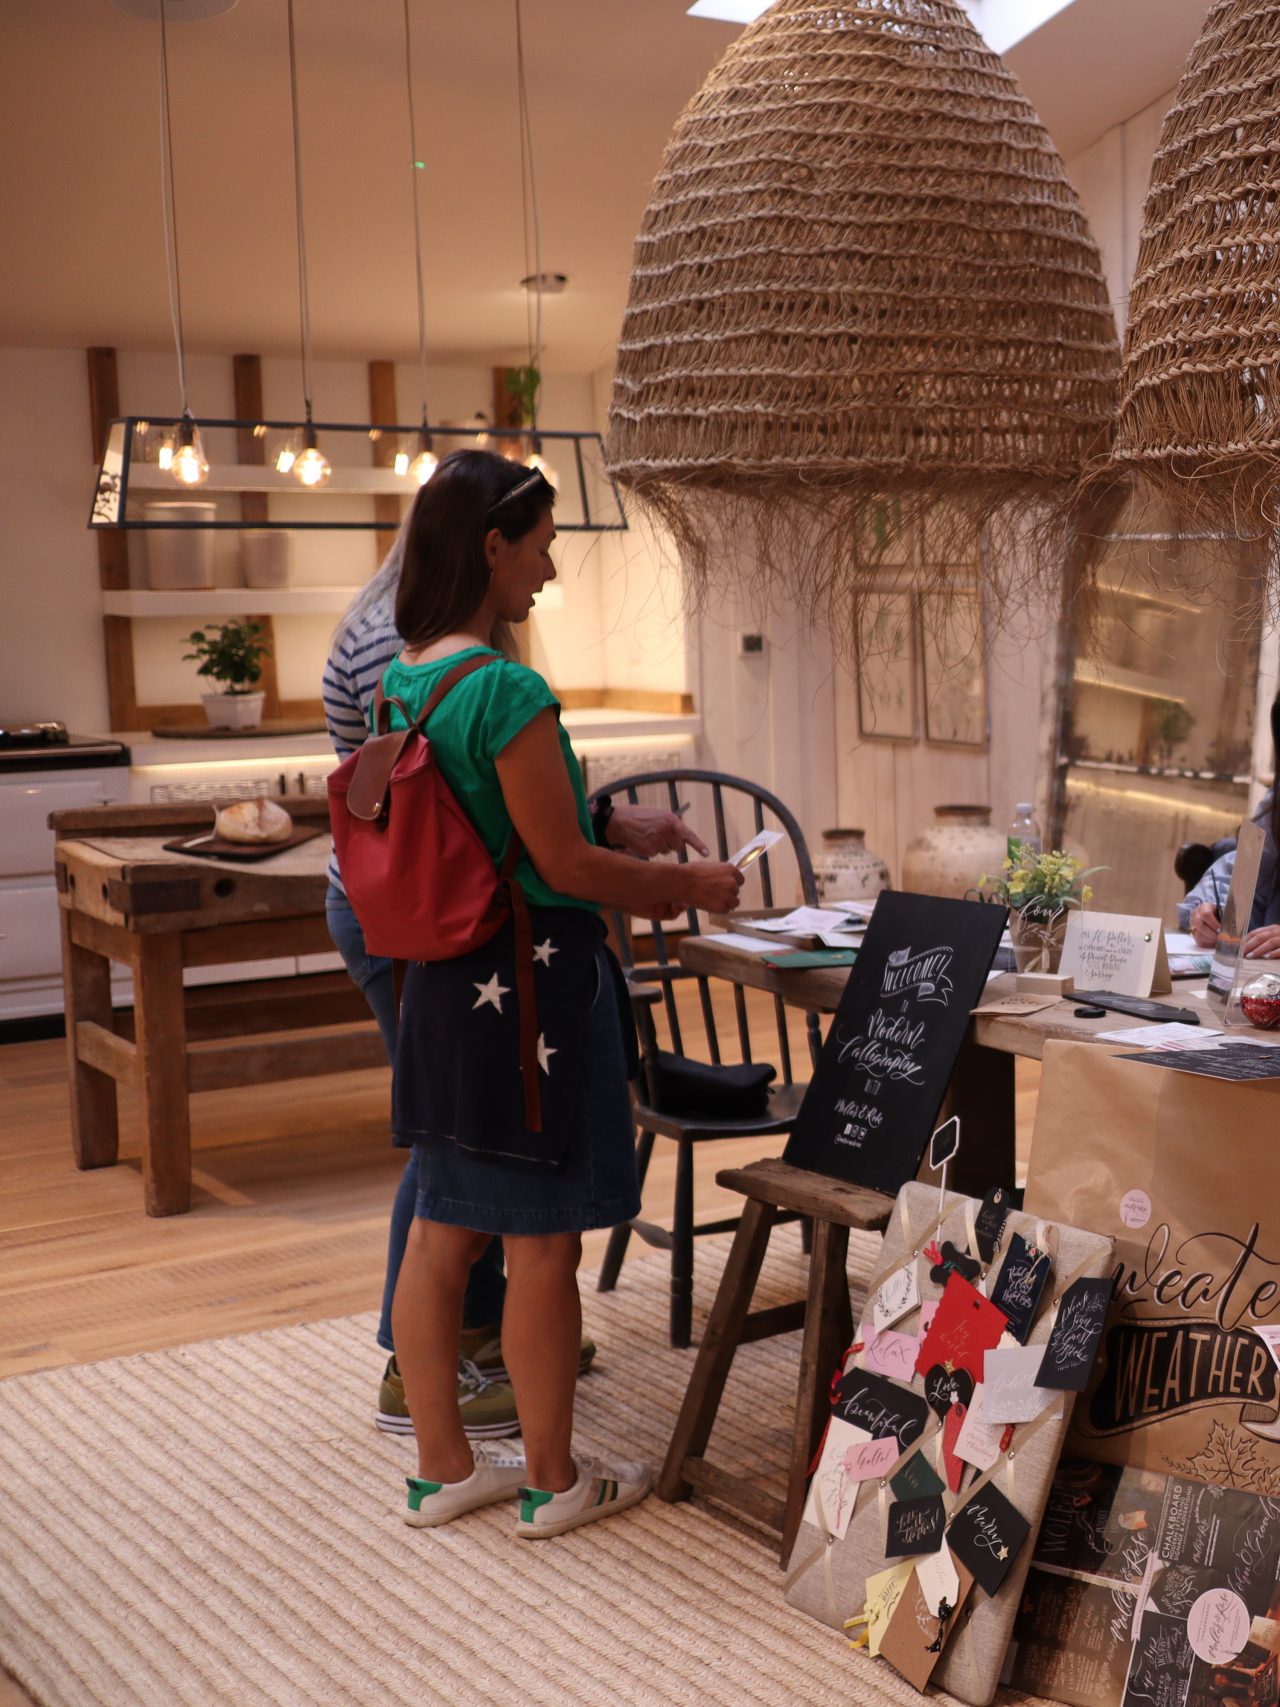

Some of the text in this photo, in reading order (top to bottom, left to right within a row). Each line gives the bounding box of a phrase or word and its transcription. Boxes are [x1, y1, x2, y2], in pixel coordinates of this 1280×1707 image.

[885, 952, 946, 992] WELCOME!
[836, 1023, 926, 1086] Calligraphy
[867, 1008, 925, 1050] Modern
[1062, 1290, 1089, 1329] Please
[866, 1336, 912, 1367] Relax
[1113, 1331, 1269, 1423] WEATHER
[930, 1375, 960, 1401] Love
[841, 1387, 918, 1448] beautiful
[965, 1503, 1002, 1560] Merry
[1161, 1484, 1183, 1559] CHALKBOARD
[1169, 1496, 1186, 1561] MODERN LETTERING
[1174, 1533, 1184, 1562] SIGNAGE
[1180, 1485, 1193, 1528] ADVERTISING
[1122, 1530, 1155, 1574] Rose
